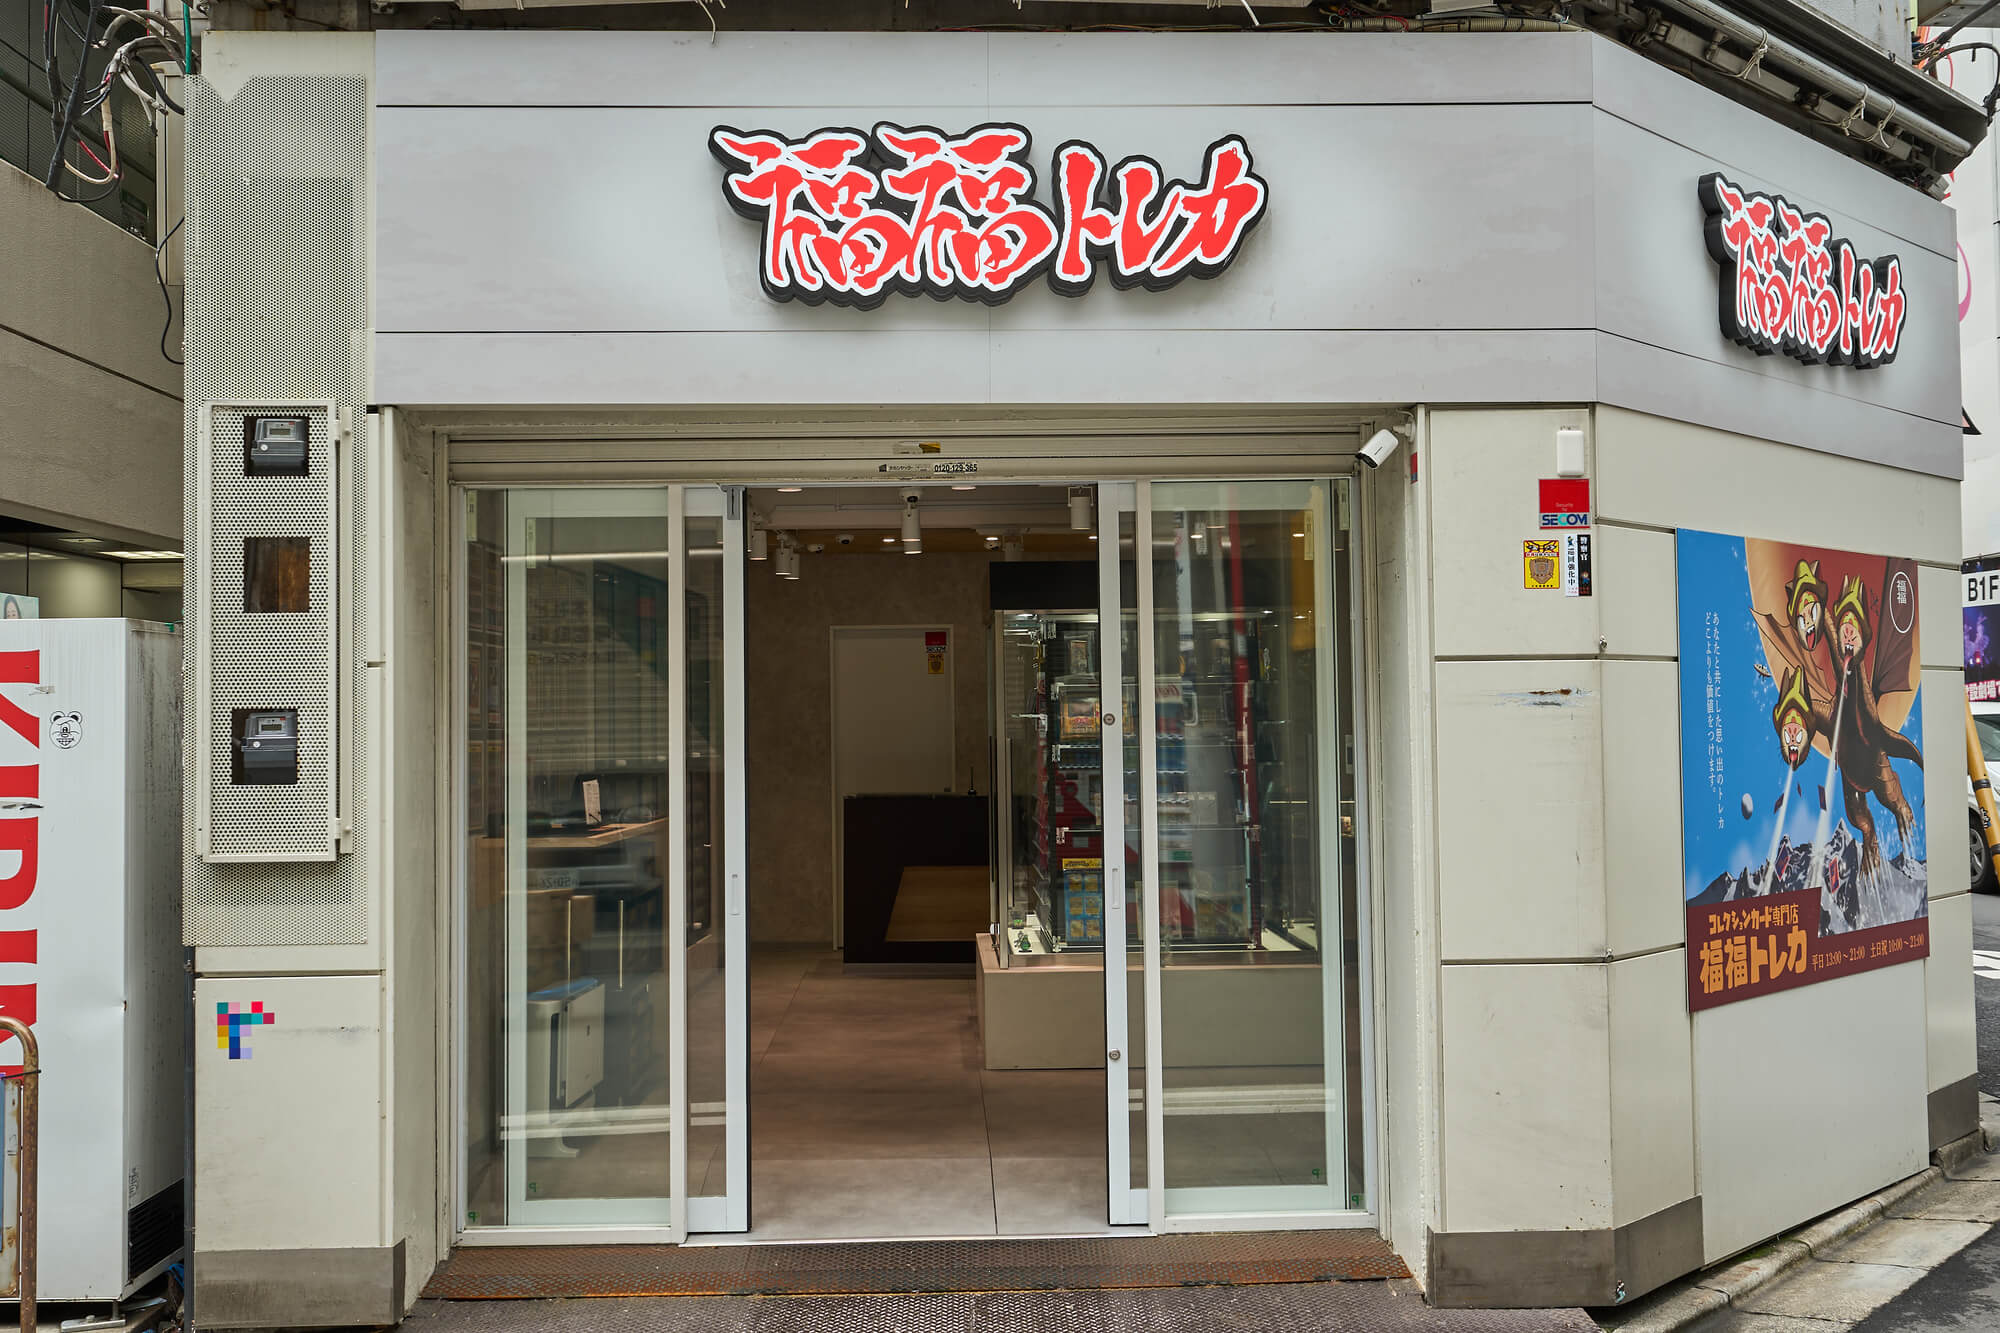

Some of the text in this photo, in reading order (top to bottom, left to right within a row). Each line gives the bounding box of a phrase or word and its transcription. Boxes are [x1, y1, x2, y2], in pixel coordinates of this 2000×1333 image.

[1542, 513, 1588, 527] SECOM
[1968, 574, 1999, 601] B1F
[1708, 903, 1799, 935] コレクションカード専門店
[1699, 925, 1808, 994] 福福トレカ
